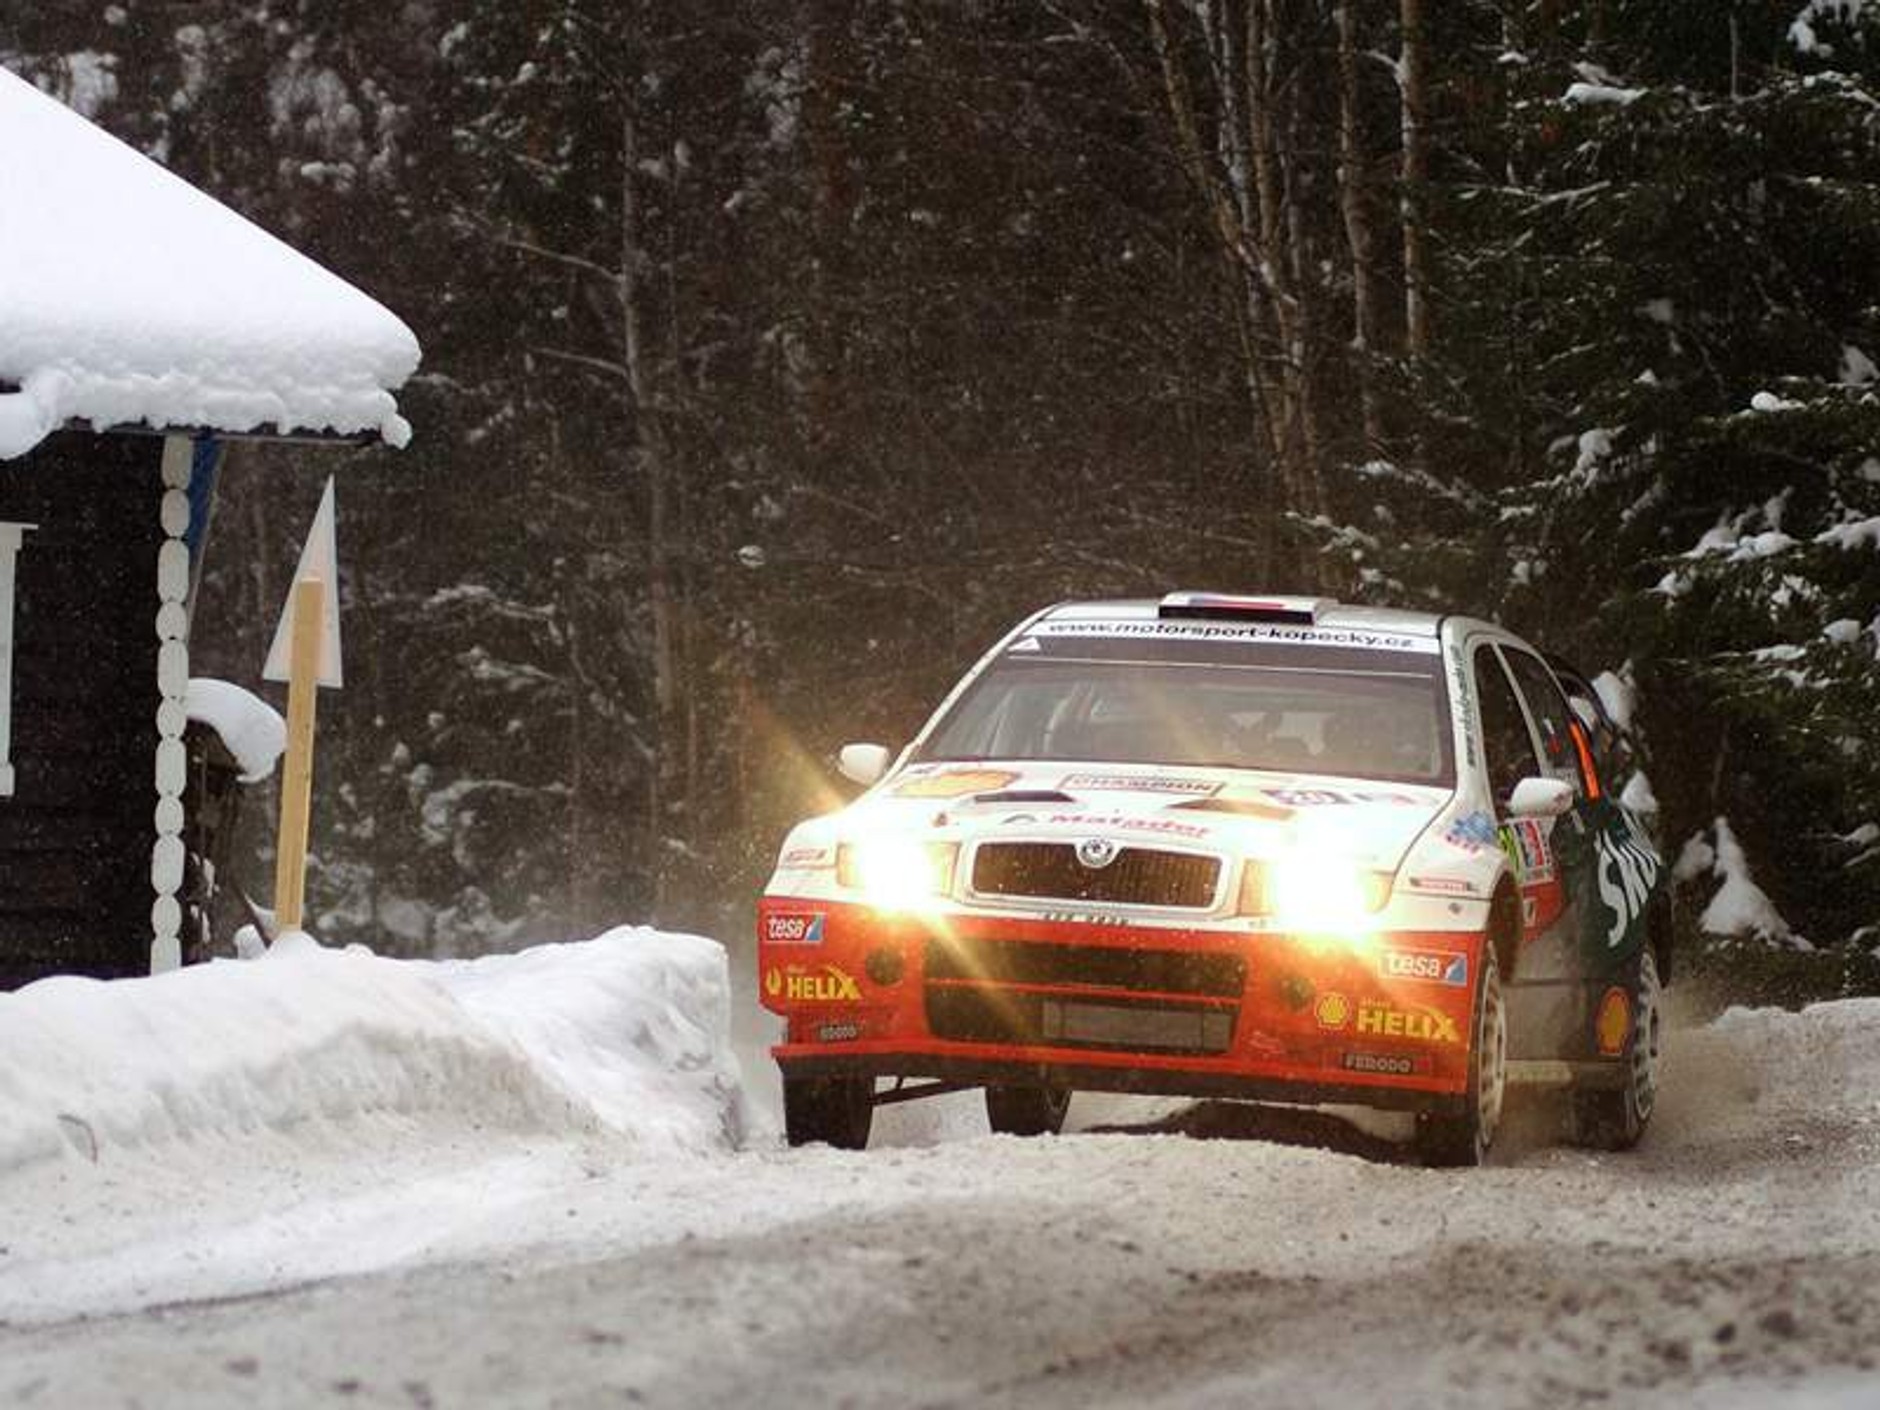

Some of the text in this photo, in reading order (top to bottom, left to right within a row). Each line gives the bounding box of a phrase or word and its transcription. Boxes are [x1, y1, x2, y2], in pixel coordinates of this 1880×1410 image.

[767, 916, 805, 939] tesa
[1389, 952, 1441, 978] tesa
[787, 968, 862, 1000] HELIX
[1357, 1006, 1460, 1041] HELIX
